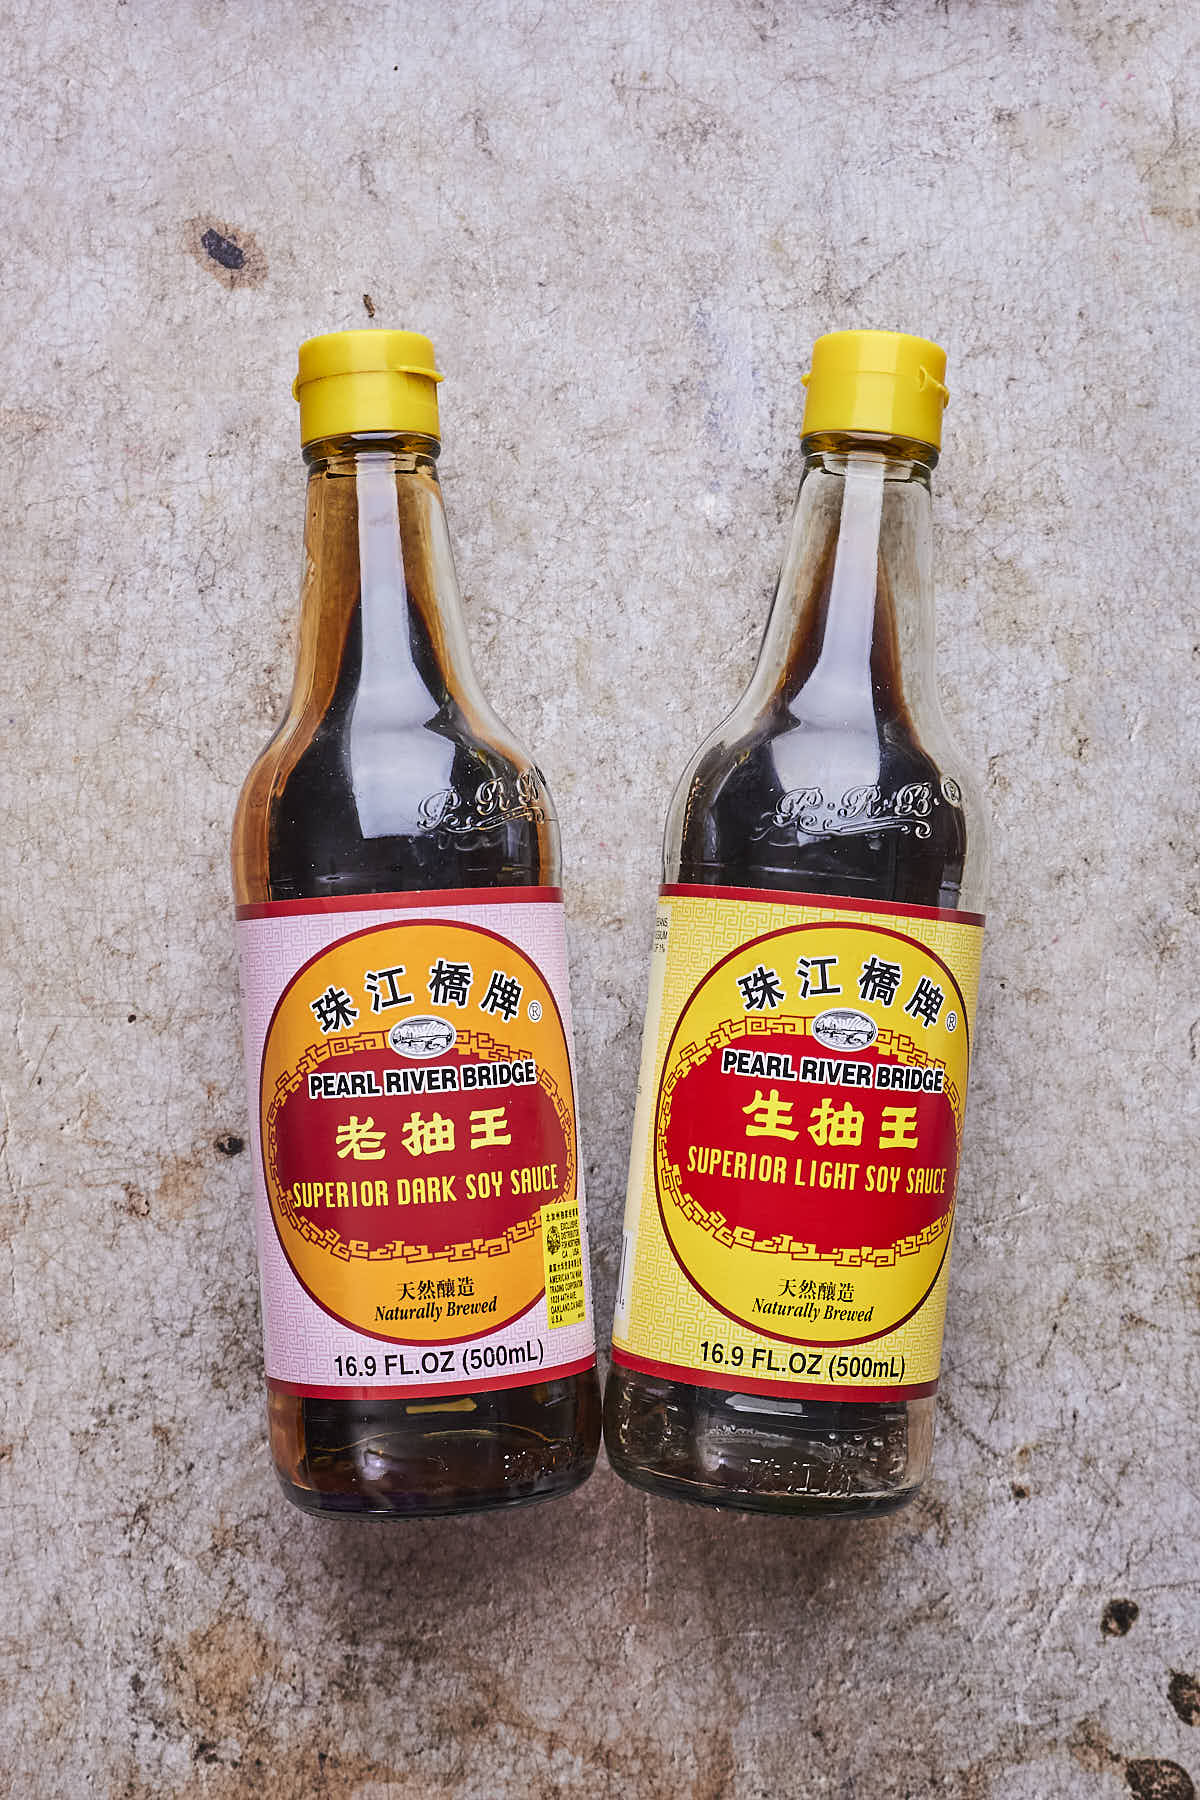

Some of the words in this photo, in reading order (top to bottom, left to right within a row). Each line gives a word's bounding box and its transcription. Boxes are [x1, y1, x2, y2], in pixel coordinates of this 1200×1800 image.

[311, 959, 523, 1033] 珠江橋牌
[738, 955, 945, 1028] 珠江橋牌
[309, 1071, 380, 1097] PEARL
[386, 1068, 456, 1093] RIVER
[463, 1061, 535, 1087] BRIDGE
[722, 1050, 795, 1079] PEARL
[801, 1060, 872, 1085] RIVER
[877, 1066, 946, 1092] BRIDGE
[335, 1106, 512, 1161] 老抽王
[742, 1089, 920, 1150] 生抽王
[292, 1181, 389, 1209] SUPERIOR
[397, 1175, 457, 1206] DARK
[466, 1170, 503, 1200] SOY
[510, 1163, 559, 1191] SAUCE
[687, 1146, 787, 1184] SUPERIOR
[795, 1160, 860, 1191] LIGHT
[865, 1165, 901, 1193] SOY
[906, 1168, 947, 1194] SAUCE
[375, 1299, 443, 1322] Naturally
[447, 1296, 497, 1317] Brewed
[397, 1277, 475, 1302] 天然釀造
[752, 1297, 821, 1323] Naturally
[824, 1304, 874, 1323] Brewed
[779, 1278, 855, 1303] 天然釀造
[335, 1354, 377, 1377] 16.9
[385, 1350, 455, 1376] FL.OZ
[462, 1339, 544, 1375] (500mL)
[701, 1341, 744, 1367] 16.9
[752, 1348, 822, 1375] FL.OZ
[828, 1355, 906, 1382] (500mL)
